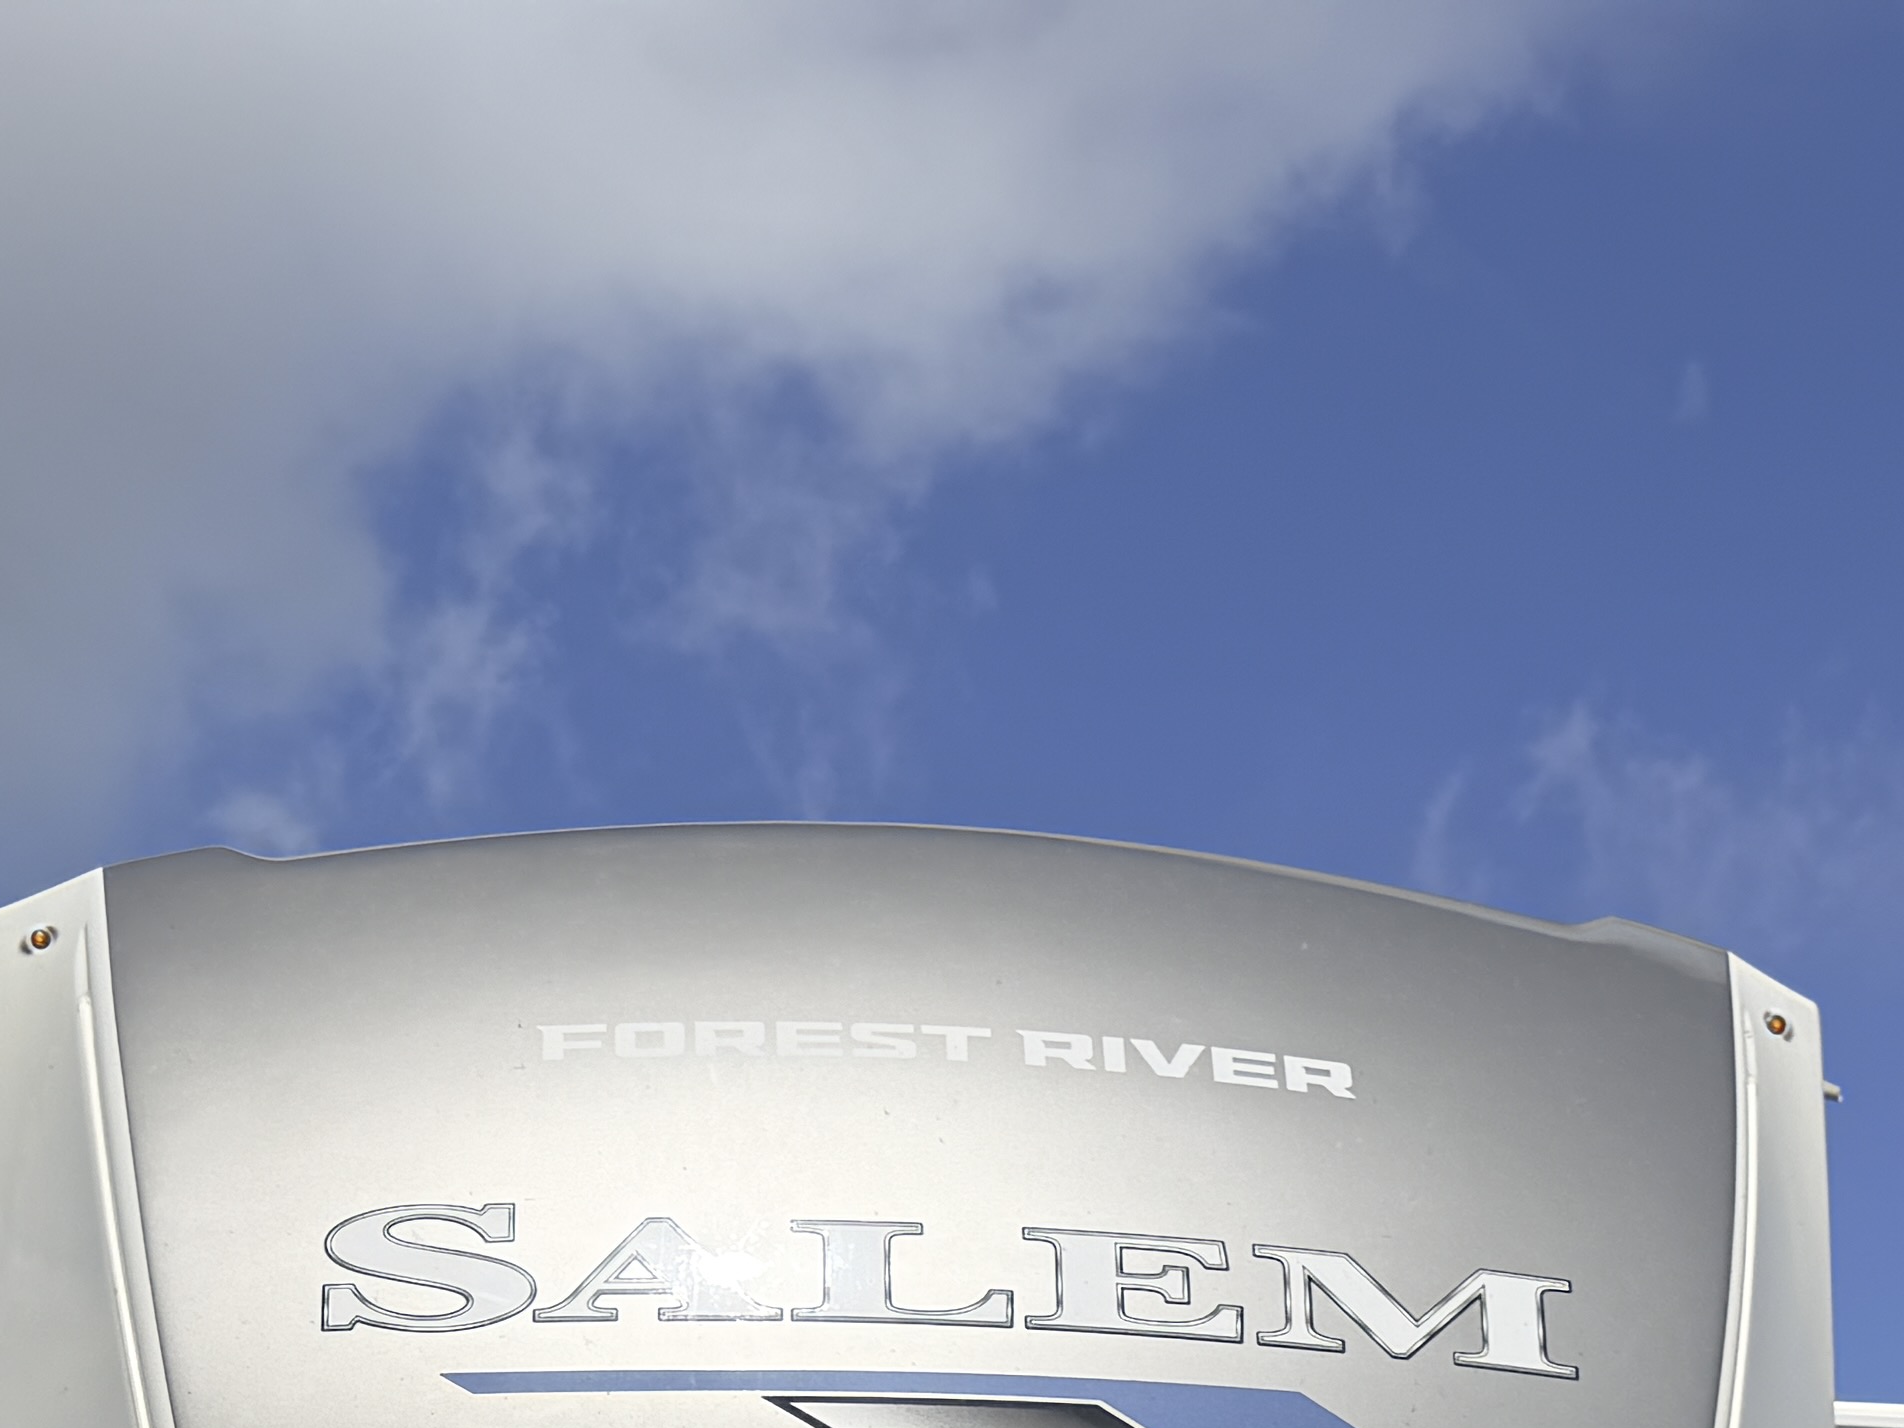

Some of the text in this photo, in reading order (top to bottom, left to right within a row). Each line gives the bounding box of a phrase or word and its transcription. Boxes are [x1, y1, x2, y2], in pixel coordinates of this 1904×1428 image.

[537, 1020, 1356, 1099] FOREST RIVER
[321, 1203, 1580, 1380] SALEM
